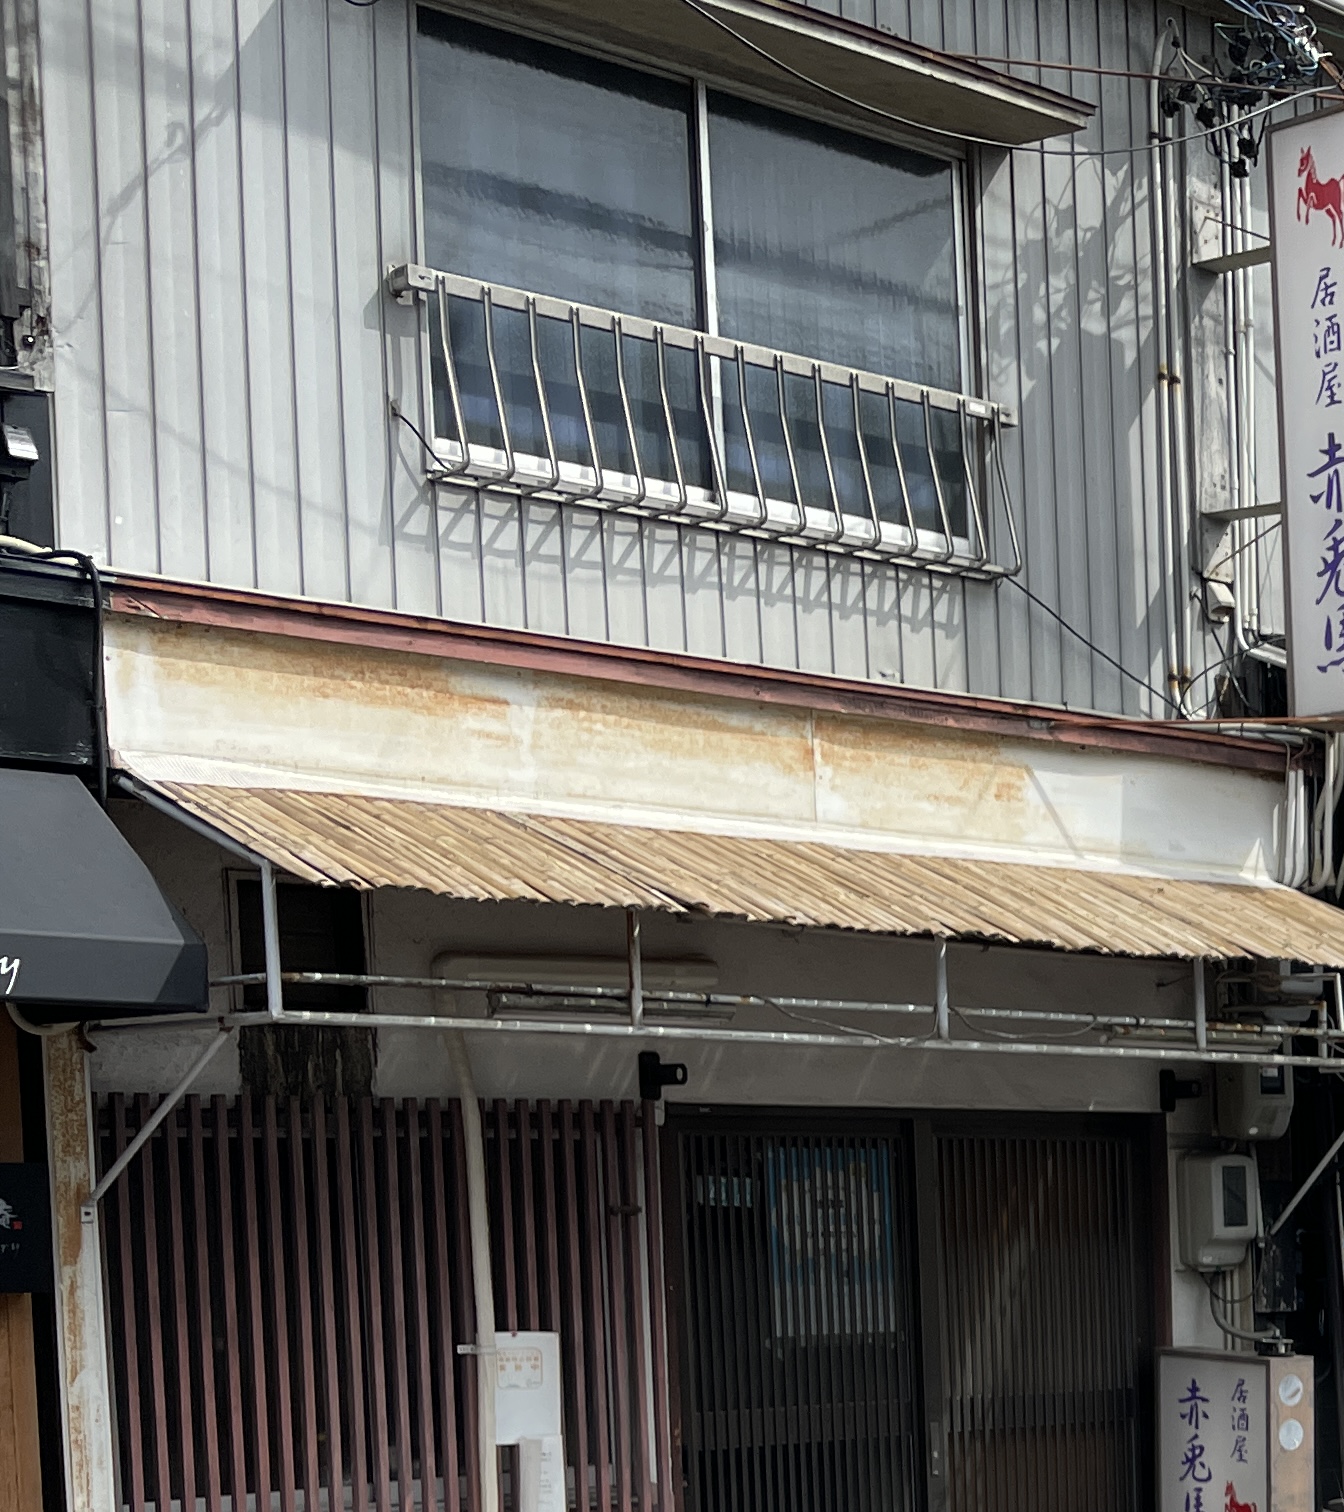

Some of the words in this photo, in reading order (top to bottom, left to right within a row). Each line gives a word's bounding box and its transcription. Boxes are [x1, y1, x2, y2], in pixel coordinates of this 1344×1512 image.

[1310, 266, 1343, 408] 居酒屋
[1230, 1377, 1250, 1465] 居酒屋
